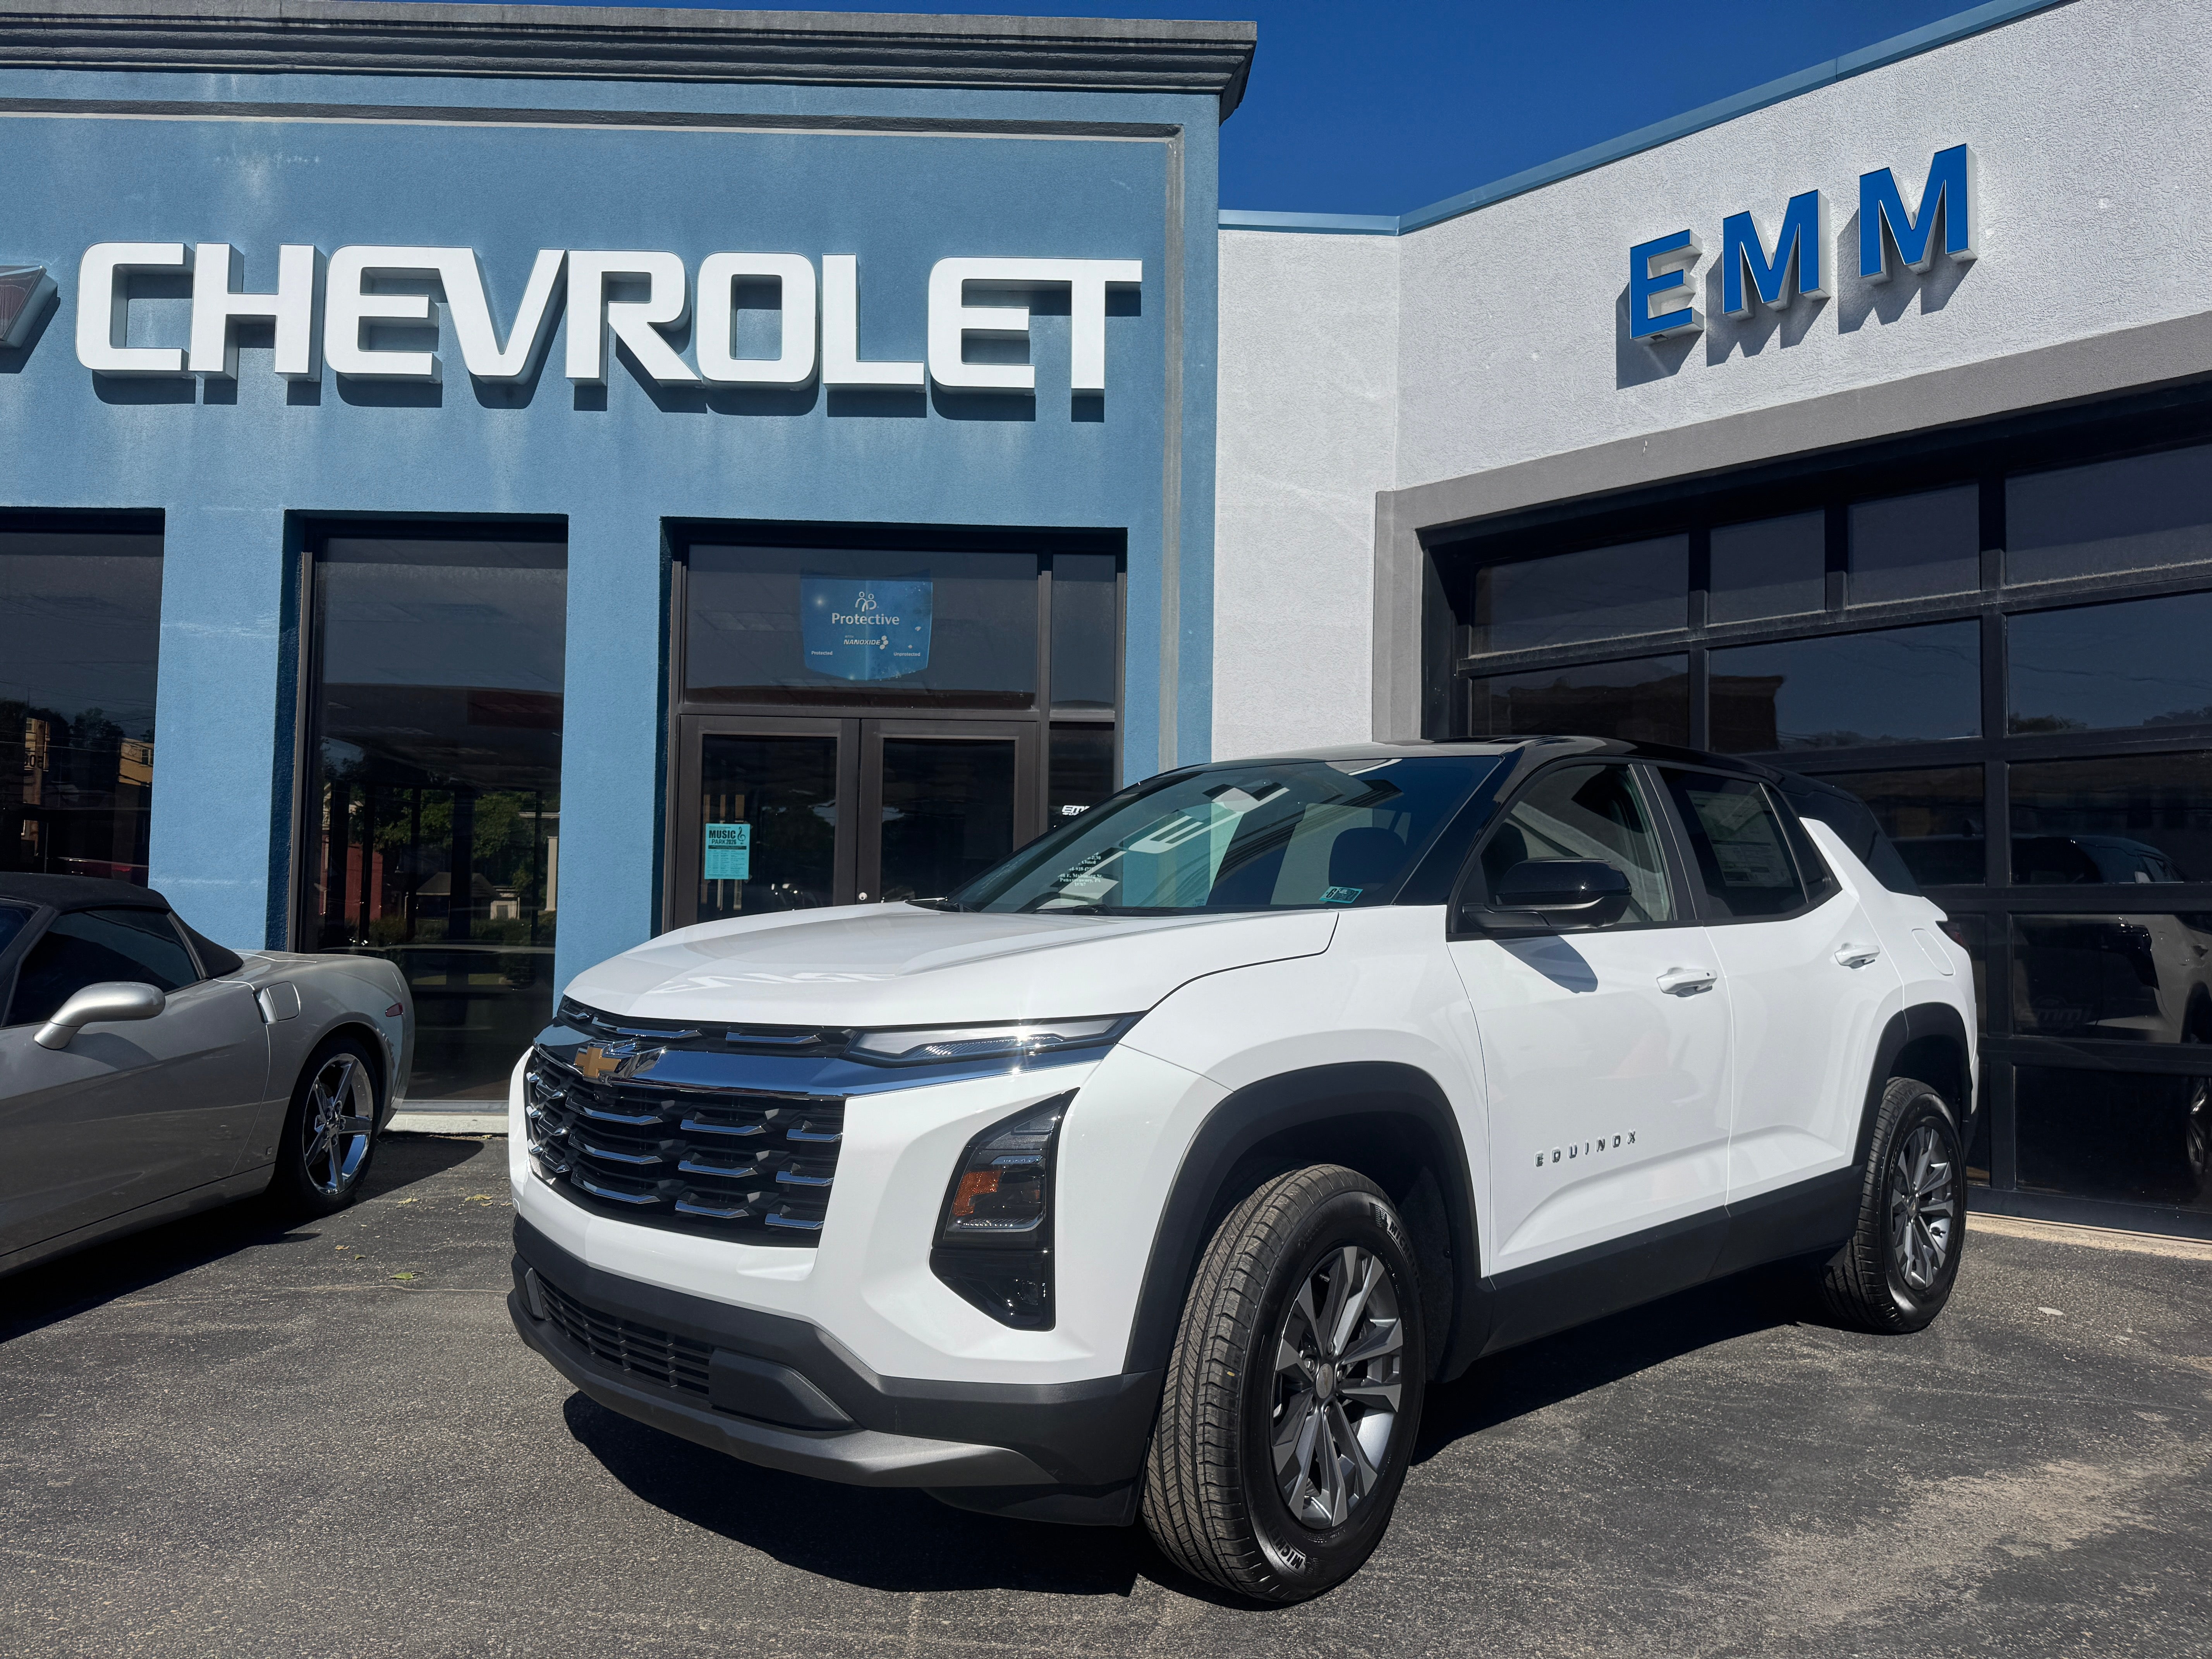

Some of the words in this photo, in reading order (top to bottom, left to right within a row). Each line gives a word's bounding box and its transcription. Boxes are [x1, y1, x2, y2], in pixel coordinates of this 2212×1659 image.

[1630, 143, 1969, 339] EMM
[76, 242, 1142, 389] CHEVROLET
[831, 612, 900, 625] Protective
[709, 830, 736, 839] MUSIC
[1534, 1129, 1635, 1167] EQUINOX
